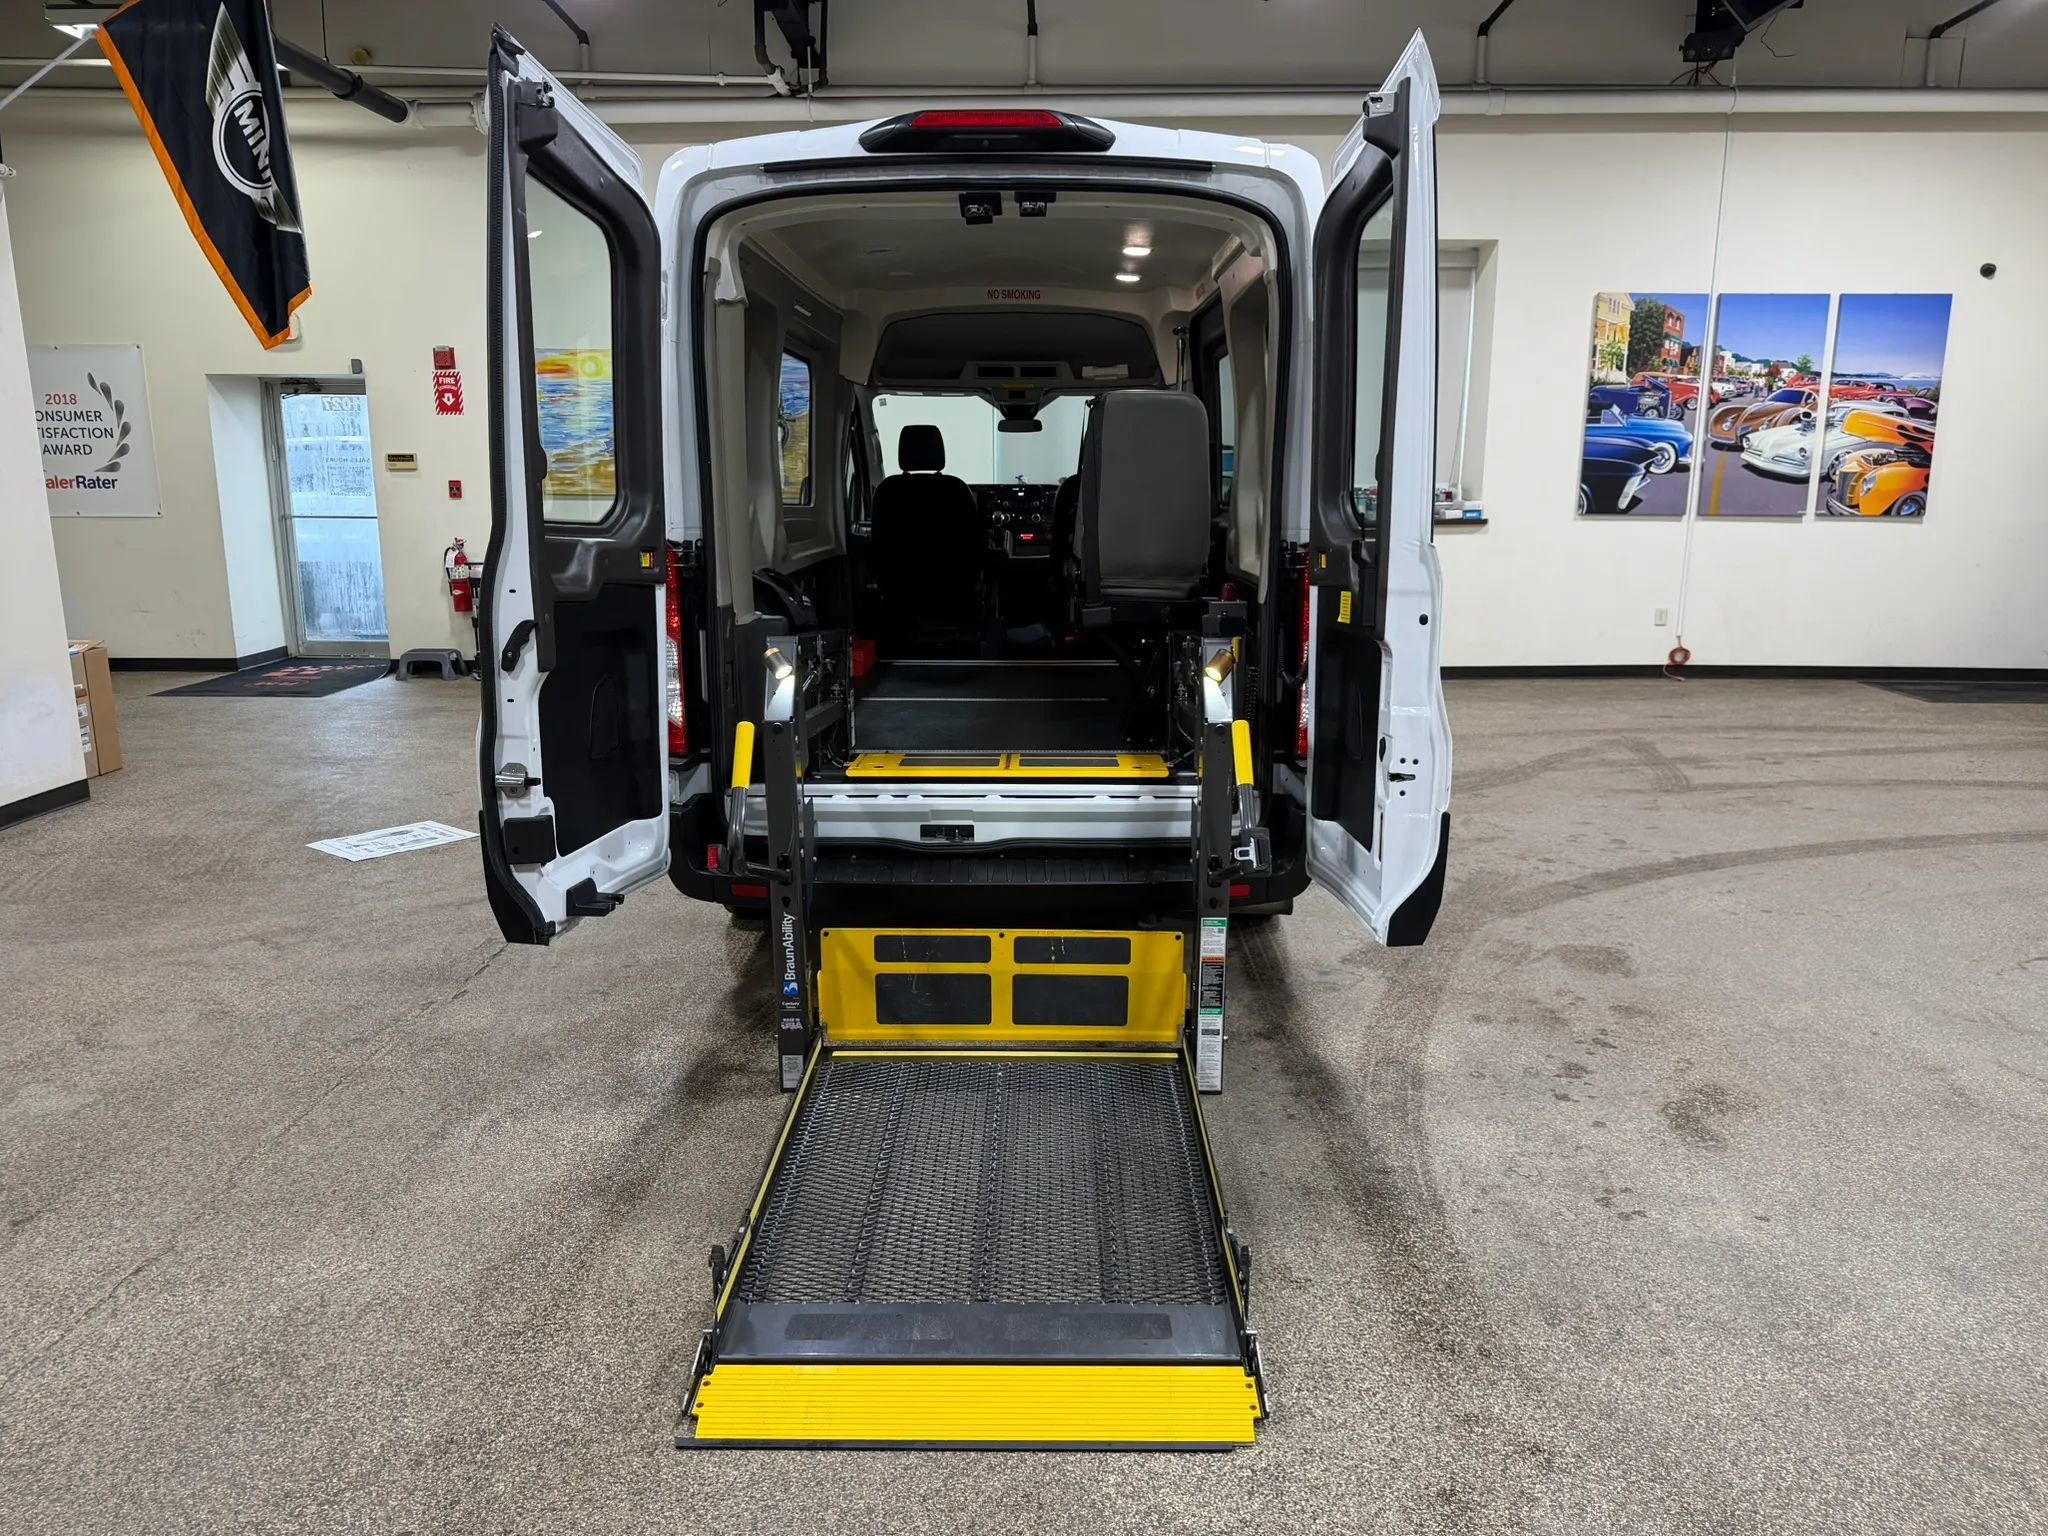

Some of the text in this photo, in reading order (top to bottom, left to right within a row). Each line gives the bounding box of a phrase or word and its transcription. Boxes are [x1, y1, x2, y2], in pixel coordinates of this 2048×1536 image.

[233, 99, 272, 181] MINI
[987, 289, 1041, 300] NO SMOKING
[45, 394, 77, 405] 2018
[35, 410, 103, 422] ONSUMER
[37, 427, 114, 439] ISFACTION
[42, 444, 93, 455] AWARD
[45, 475, 118, 489] alerRater
[782, 912, 795, 980] BraunAbility
